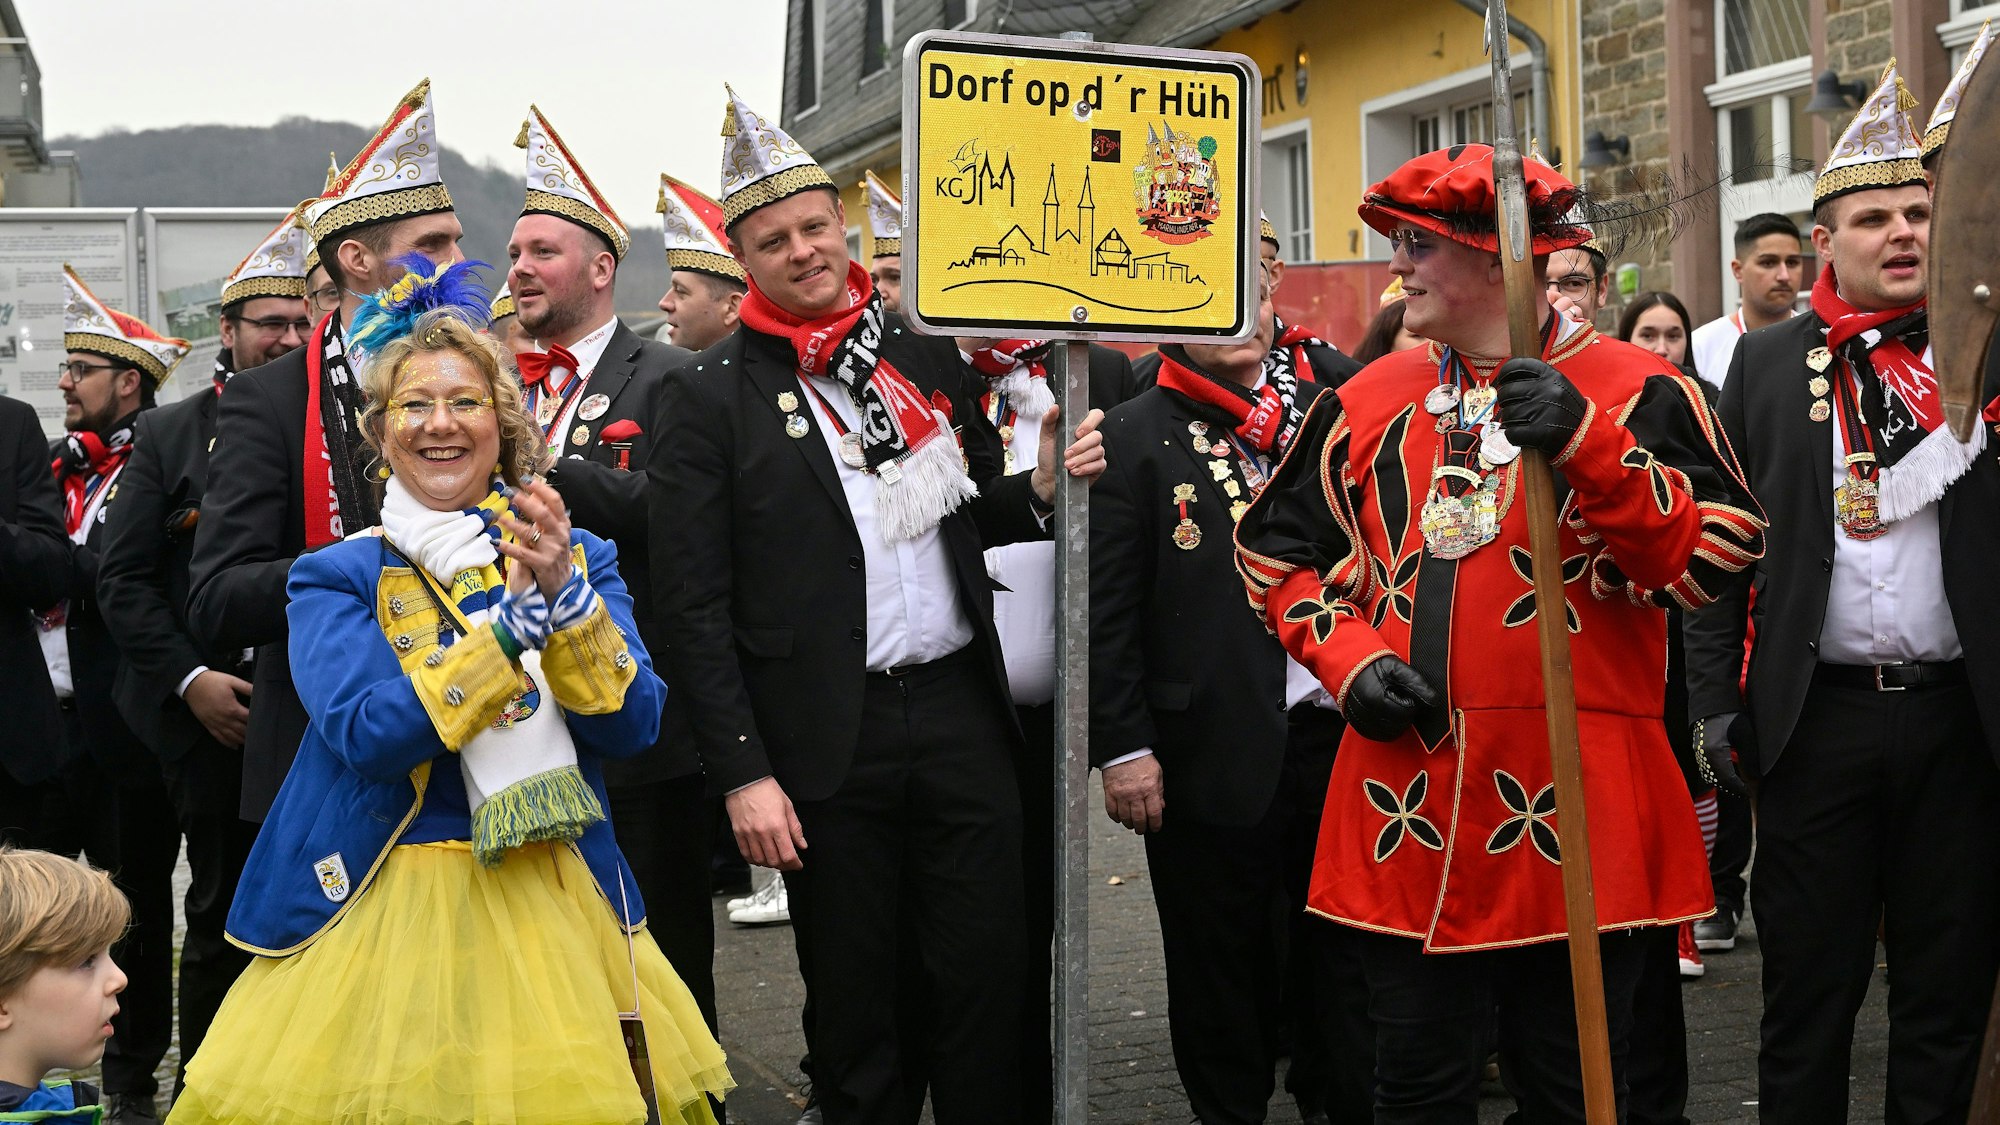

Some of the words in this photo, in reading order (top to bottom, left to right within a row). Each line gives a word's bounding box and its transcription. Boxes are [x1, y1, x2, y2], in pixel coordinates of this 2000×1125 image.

[929, 63, 1013, 103] Dorf
[1026, 80, 1069, 116] op
[1160, 81, 1230, 119] Hüh
[1166, 189, 1191, 205] 2023
